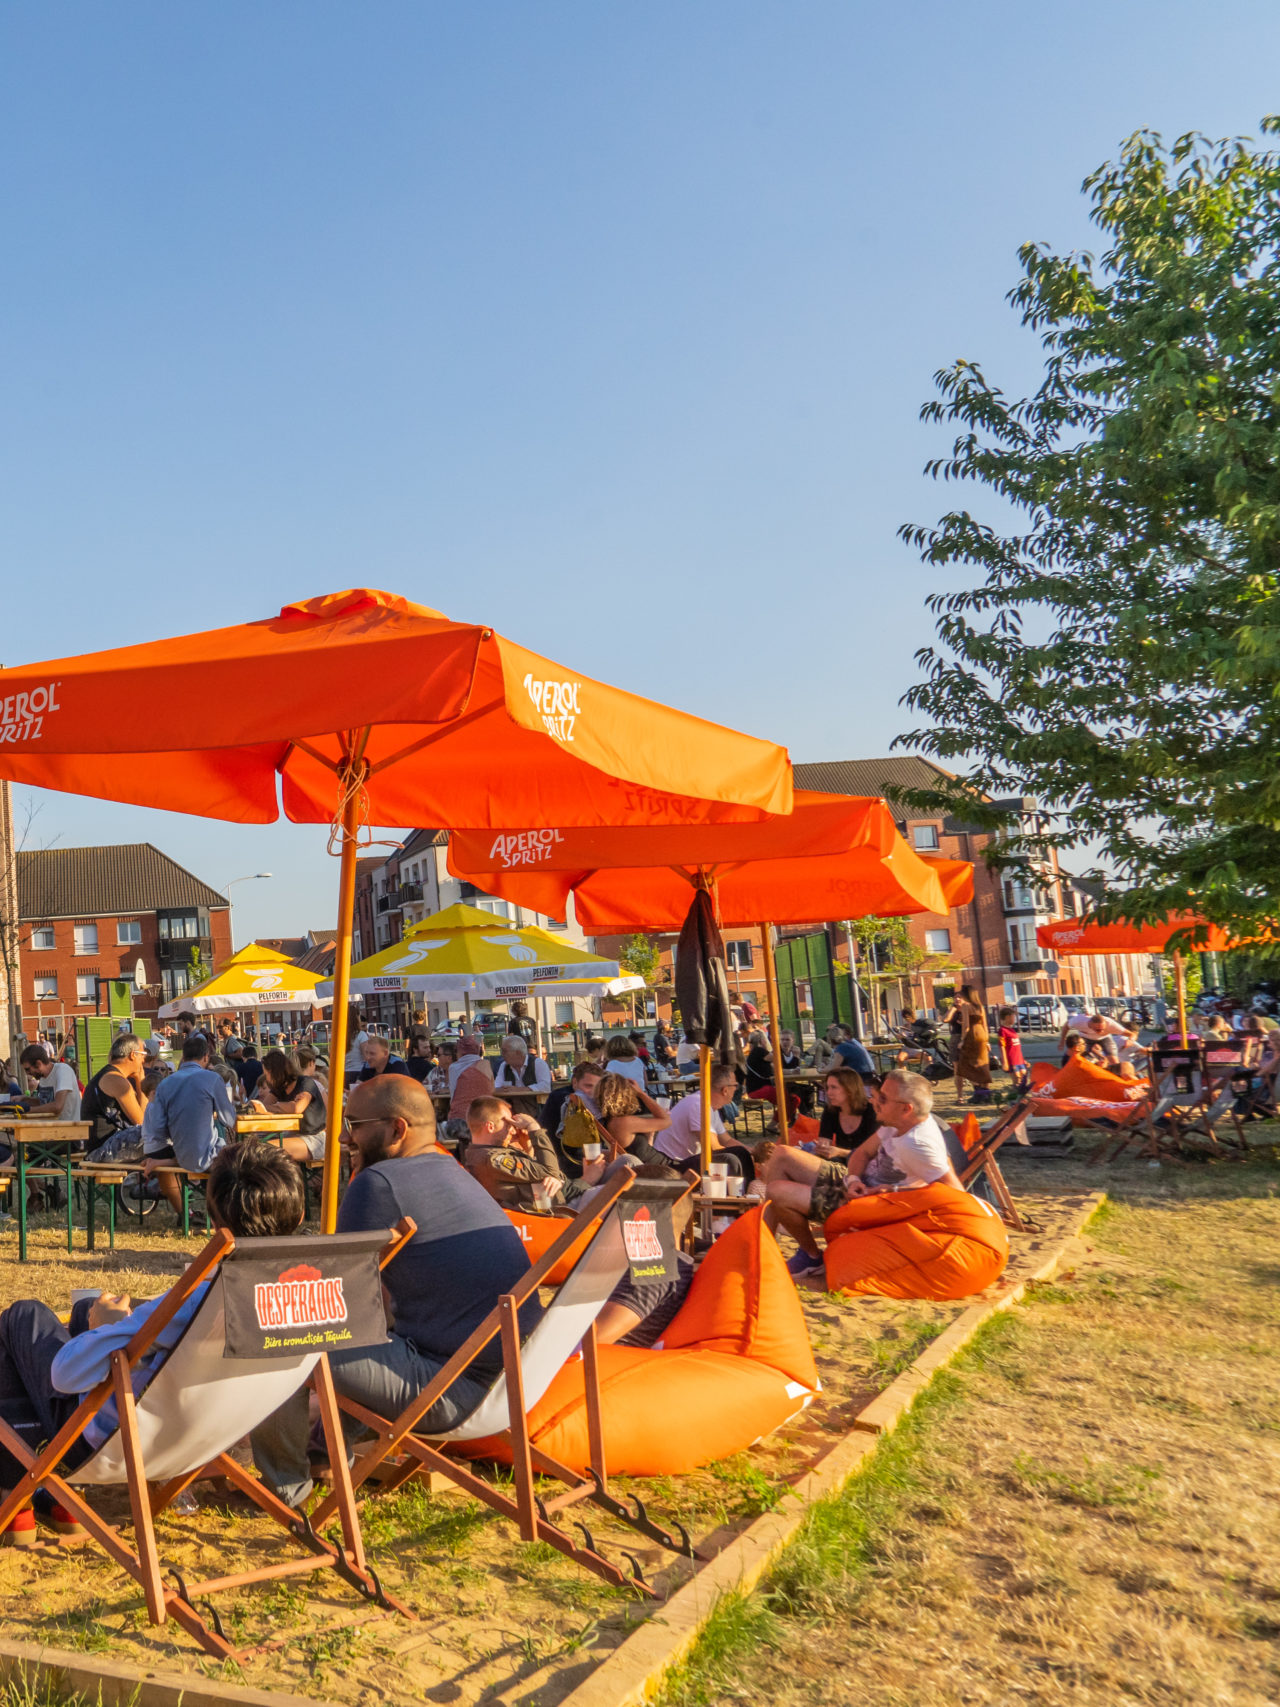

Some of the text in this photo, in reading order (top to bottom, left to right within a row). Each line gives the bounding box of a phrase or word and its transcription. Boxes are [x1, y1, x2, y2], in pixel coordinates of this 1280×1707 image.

[489, 828, 565, 859] APEROL
[532, 966, 558, 977] PELFORTH
[373, 977, 401, 987] PELFORTH
[495, 985, 527, 995] PELFORTH
[258, 991, 288, 1000] PELFORTH
[255, 1278, 347, 1329] DESPERADOS
